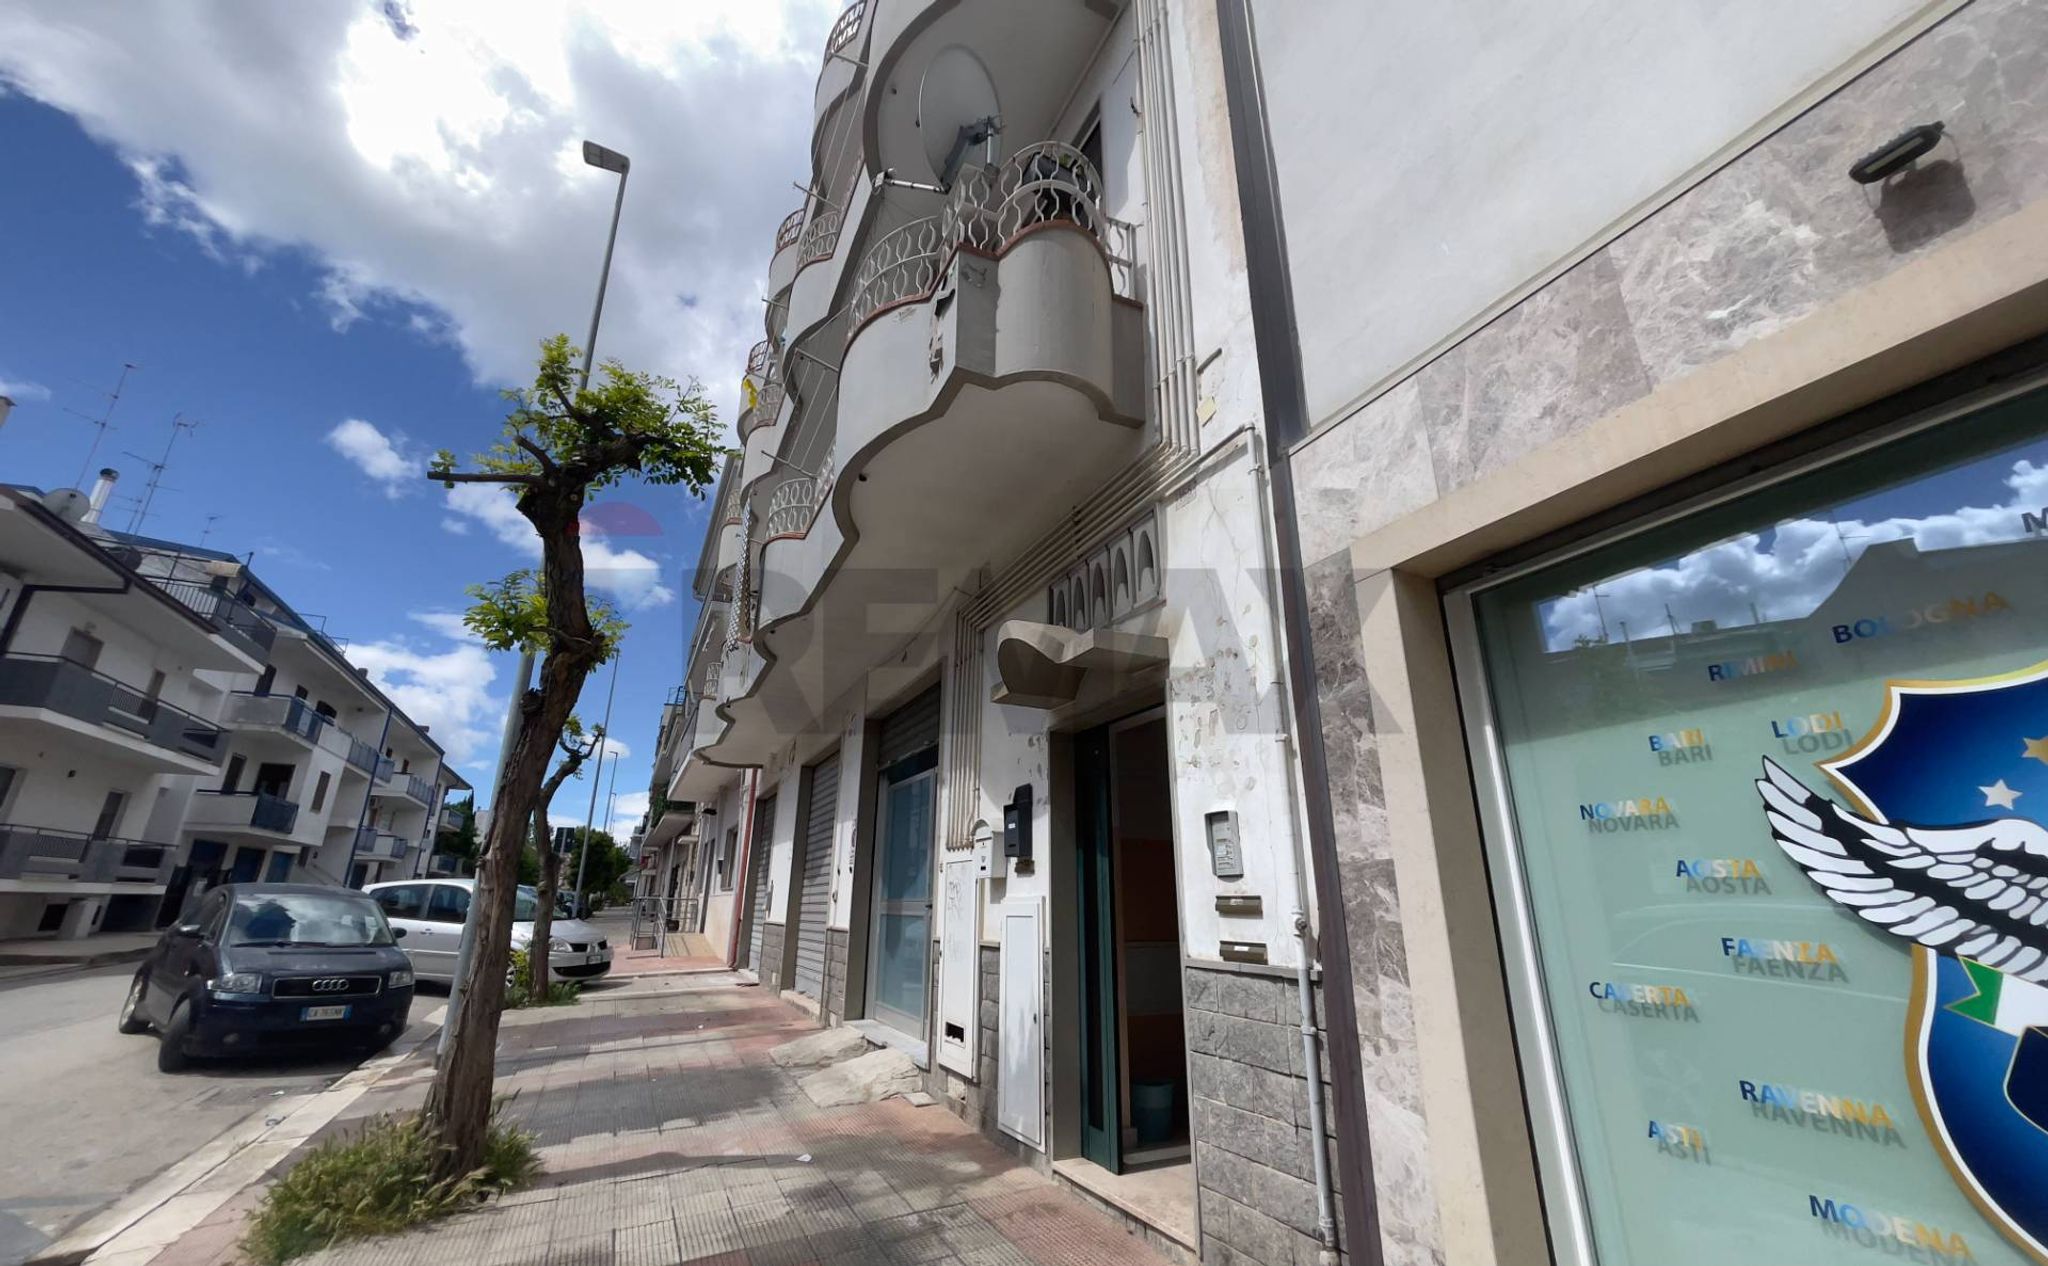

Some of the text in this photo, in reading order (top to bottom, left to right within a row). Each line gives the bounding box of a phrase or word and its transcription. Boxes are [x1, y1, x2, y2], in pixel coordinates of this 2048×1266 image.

[1771, 711, 1844, 739] LODI
[1648, 728, 1705, 751] BARI
[1580, 796, 1670, 820] NOVARA
[1676, 859, 1761, 880] AOSTA
[1721, 937, 1838, 965] FAENZA
[1589, 981, 1690, 1007] CASERTA
[1739, 1080, 1893, 1128] RAVENNA
[1648, 1120, 1703, 1152] ASTI
[1808, 1195, 1971, 1257] MODENA
